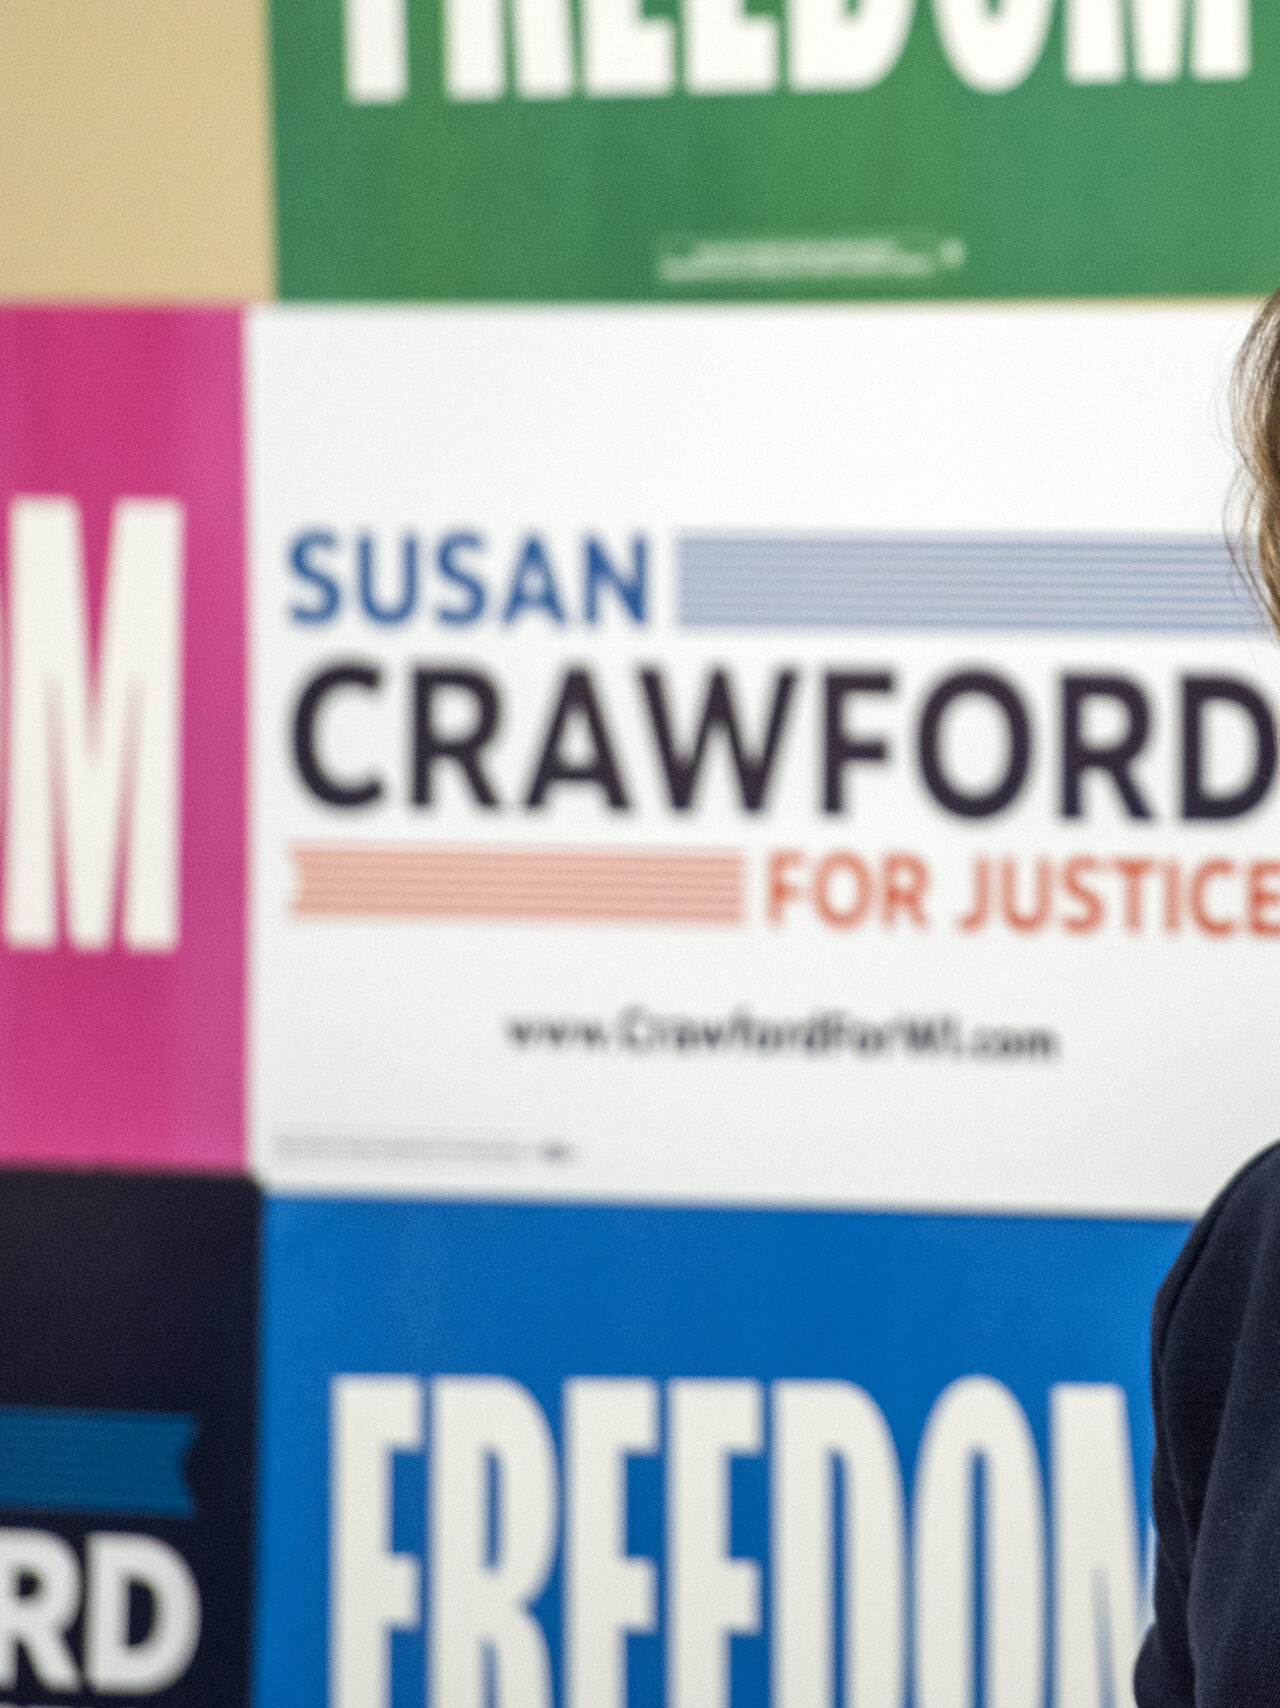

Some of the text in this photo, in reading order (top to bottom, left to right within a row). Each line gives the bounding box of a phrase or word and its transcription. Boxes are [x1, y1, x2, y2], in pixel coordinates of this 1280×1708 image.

[286, 528, 650, 629] SUSAN
[288, 656, 1279, 826] CRAWFORD
[767, 851, 930, 929] FOR
